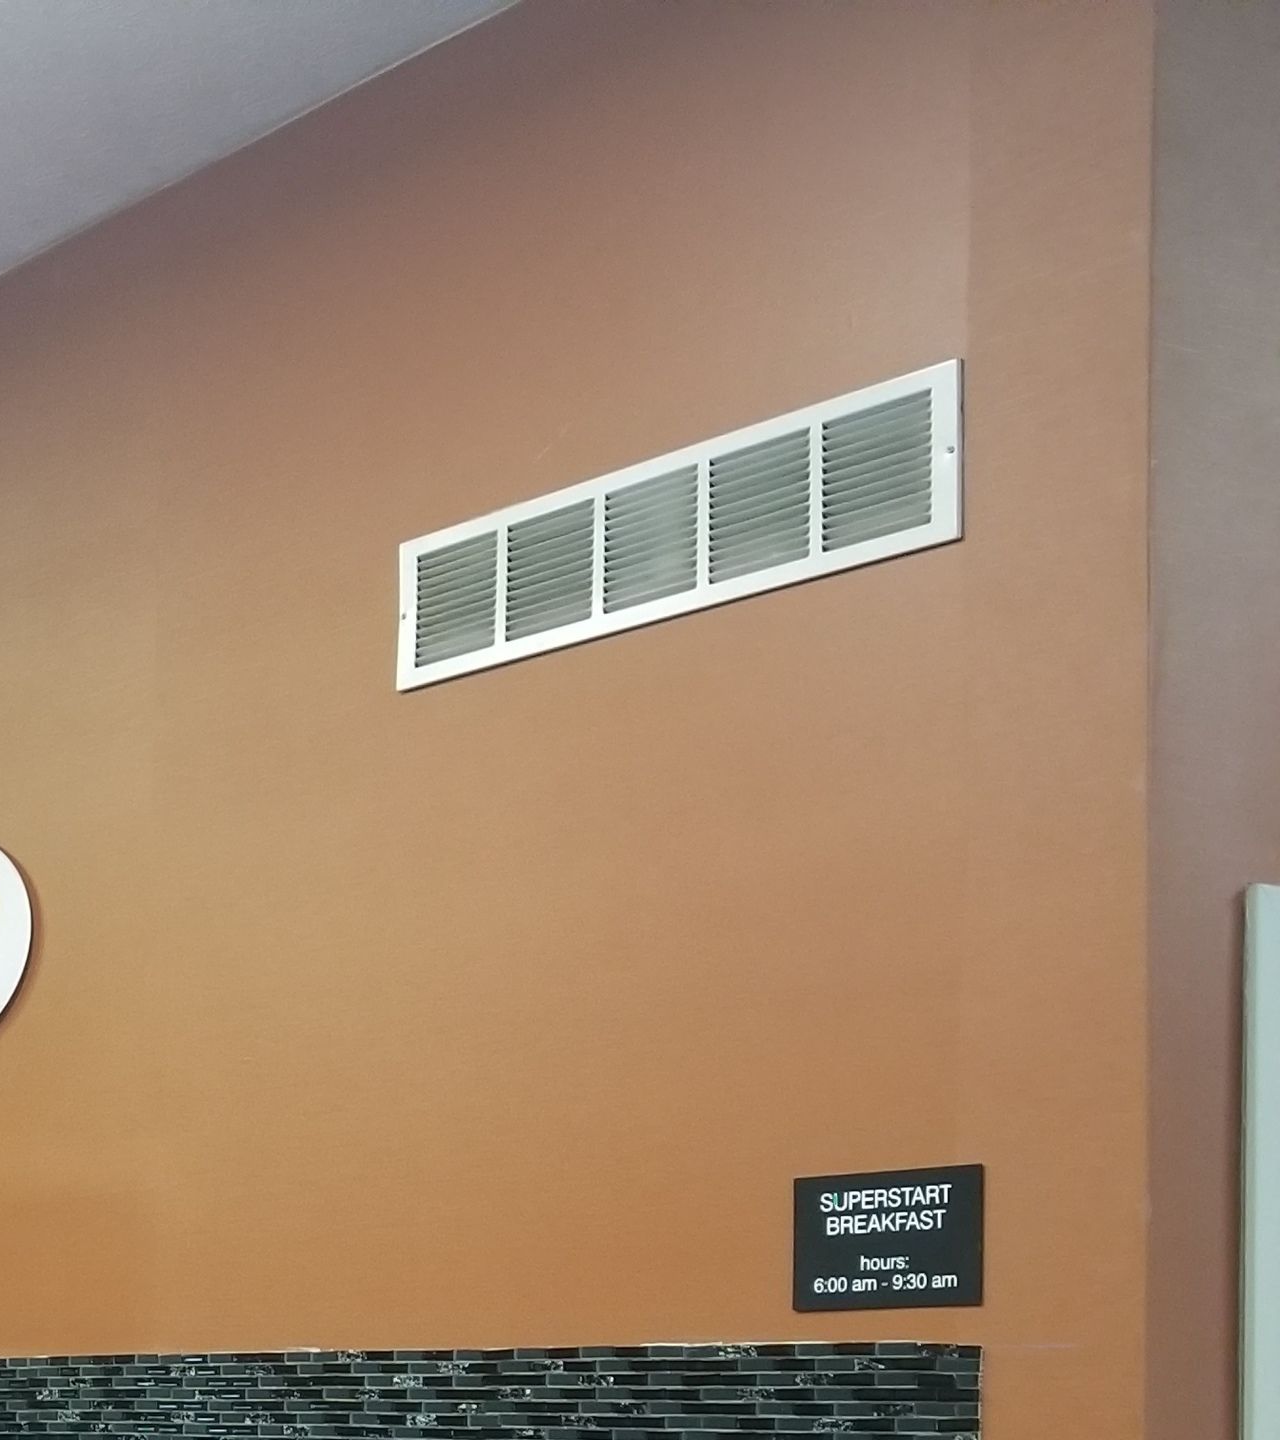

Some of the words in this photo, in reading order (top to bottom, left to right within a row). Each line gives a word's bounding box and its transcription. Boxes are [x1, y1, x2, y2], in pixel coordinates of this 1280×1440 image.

[820, 1184, 952, 1212] SUPERSTART
[826, 1210, 946, 1235] BREAKFAST
[860, 1256, 909, 1271] hours:
[813, 1277, 847, 1293] 6:00
[852, 1277, 877, 1291] am
[892, 1274, 927, 1290] 9:30
[931, 1273, 957, 1288] am
